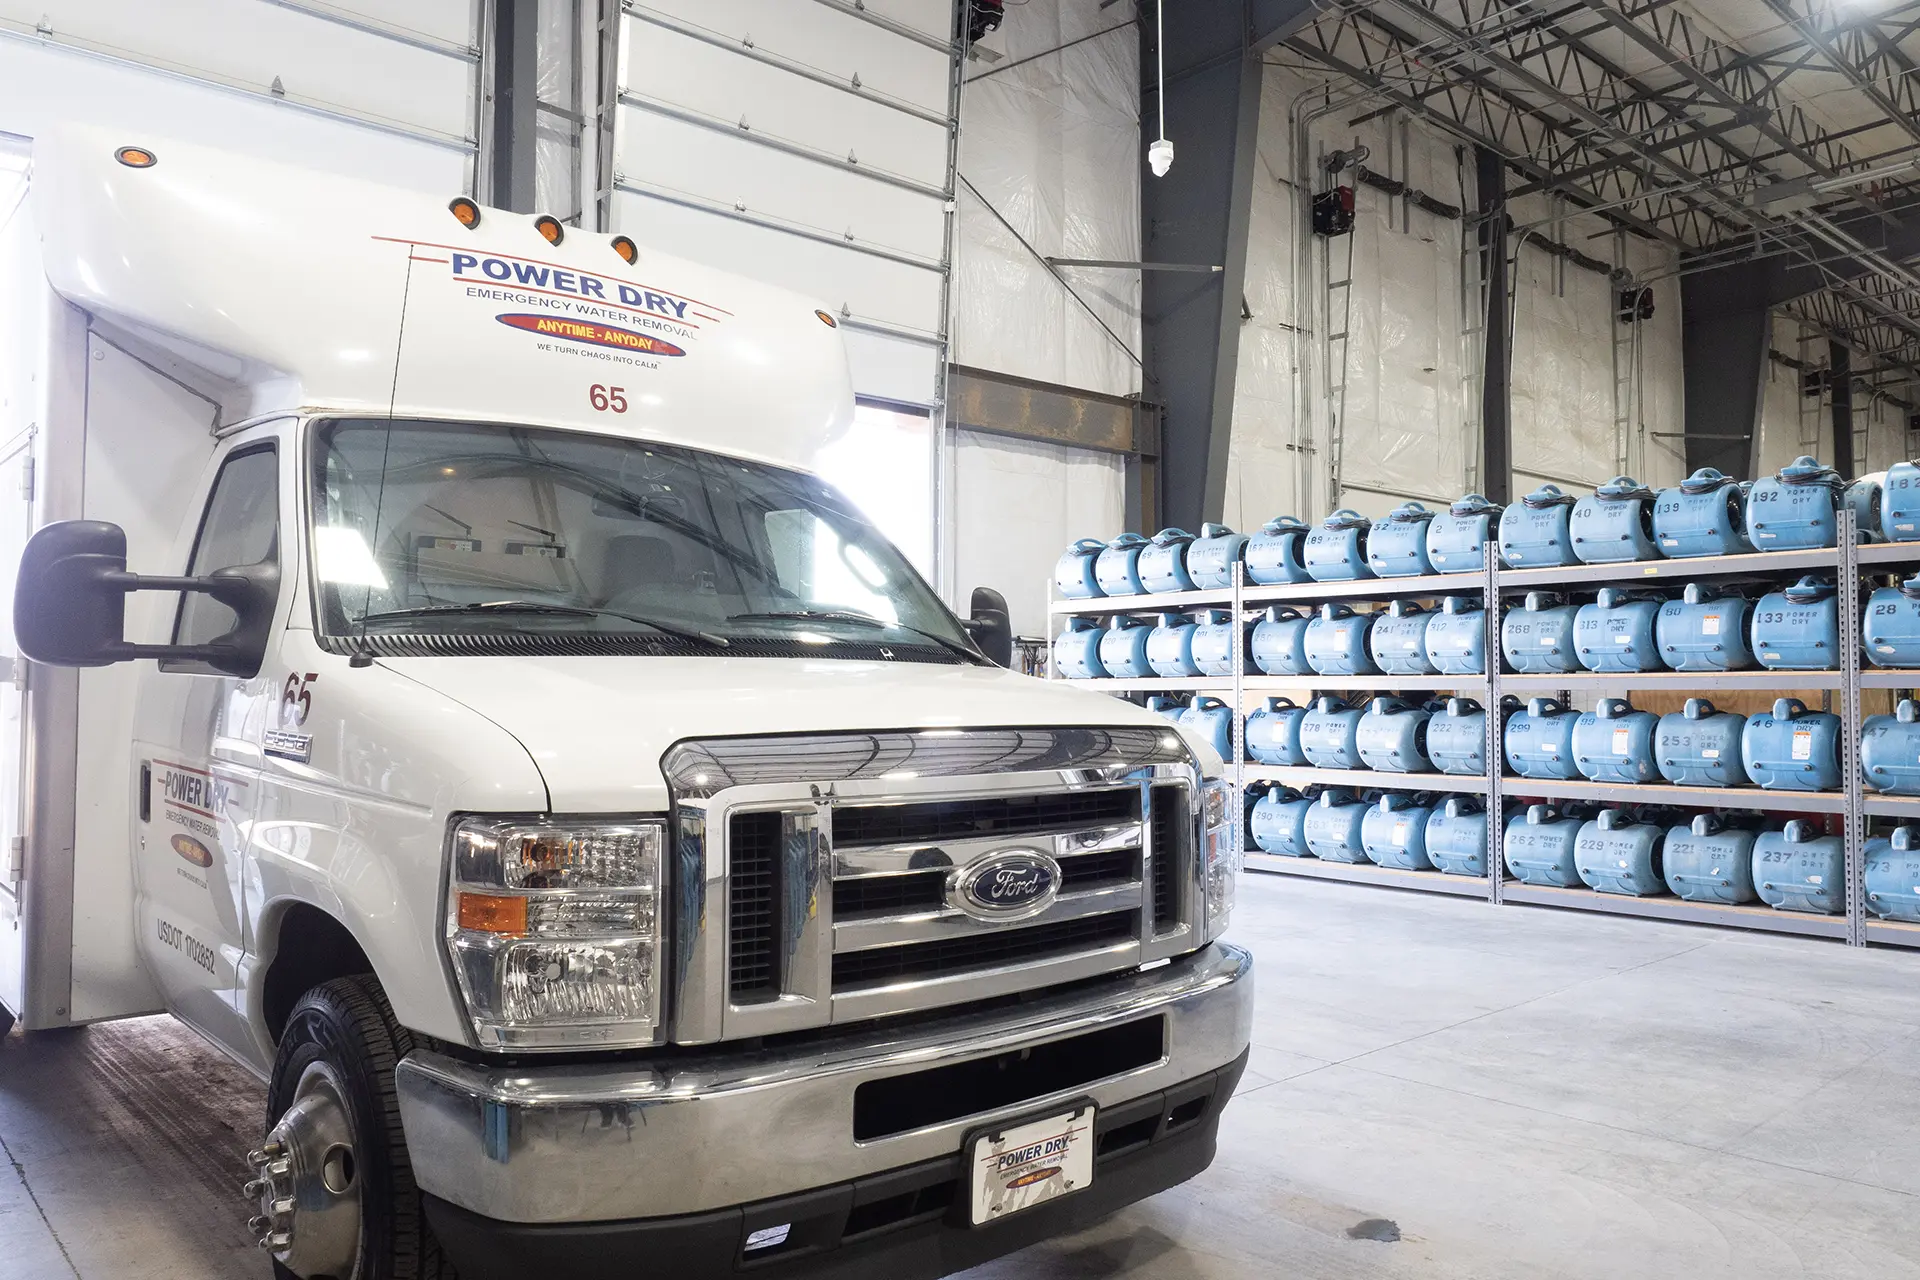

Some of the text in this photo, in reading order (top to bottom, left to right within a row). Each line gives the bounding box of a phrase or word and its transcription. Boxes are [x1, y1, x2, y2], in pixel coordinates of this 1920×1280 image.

[453, 253, 687, 319] POWER DRY
[466, 287, 698, 340] EMERGENCY WATER REMOVAL
[537, 319, 595, 338] ANYTIME
[604, 331, 652, 350] ANYDAY
[537, 343, 551, 351] WE
[554, 345, 578, 355] TURN
[581, 348, 611, 361] CHAOS
[613, 355, 633, 365] INTO
[589, 383, 628, 413] 65
[1753, 491, 1778, 502] 192
[1787, 488, 1818, 496] POWER
[1575, 508, 1592, 518] 40
[1657, 502, 1679, 514] 139
[1504, 515, 1519, 525] 53
[1436, 525, 1442, 533] 2
[1307, 535, 1323, 544] 189
[1665, 607, 1681, 616] 80
[1875, 604, 1896, 615] 28
[1757, 612, 1783, 623] 133
[1508, 624, 1530, 634] 268
[279, 672, 319, 728] 65
[1304, 723, 1320, 732] 278
[1580, 718, 1595, 726] 99
[1752, 720, 1773, 728] 46
[1432, 724, 1452, 732] 222
[1510, 723, 1531, 733] 299
[1867, 727, 1888, 737] 47
[1662, 735, 1691, 746] 253
[165, 771, 229, 813] POWER DRY
[1256, 811, 1273, 820] 290
[1510, 835, 1535, 846] 262
[1539, 835, 1563, 843] POWER
[1763, 851, 1792, 863] 237
[991, 869, 1039, 898] Ford
[157, 918, 215, 975] USDOT 1702852
[997, 1135, 1070, 1169] POWER DRY
